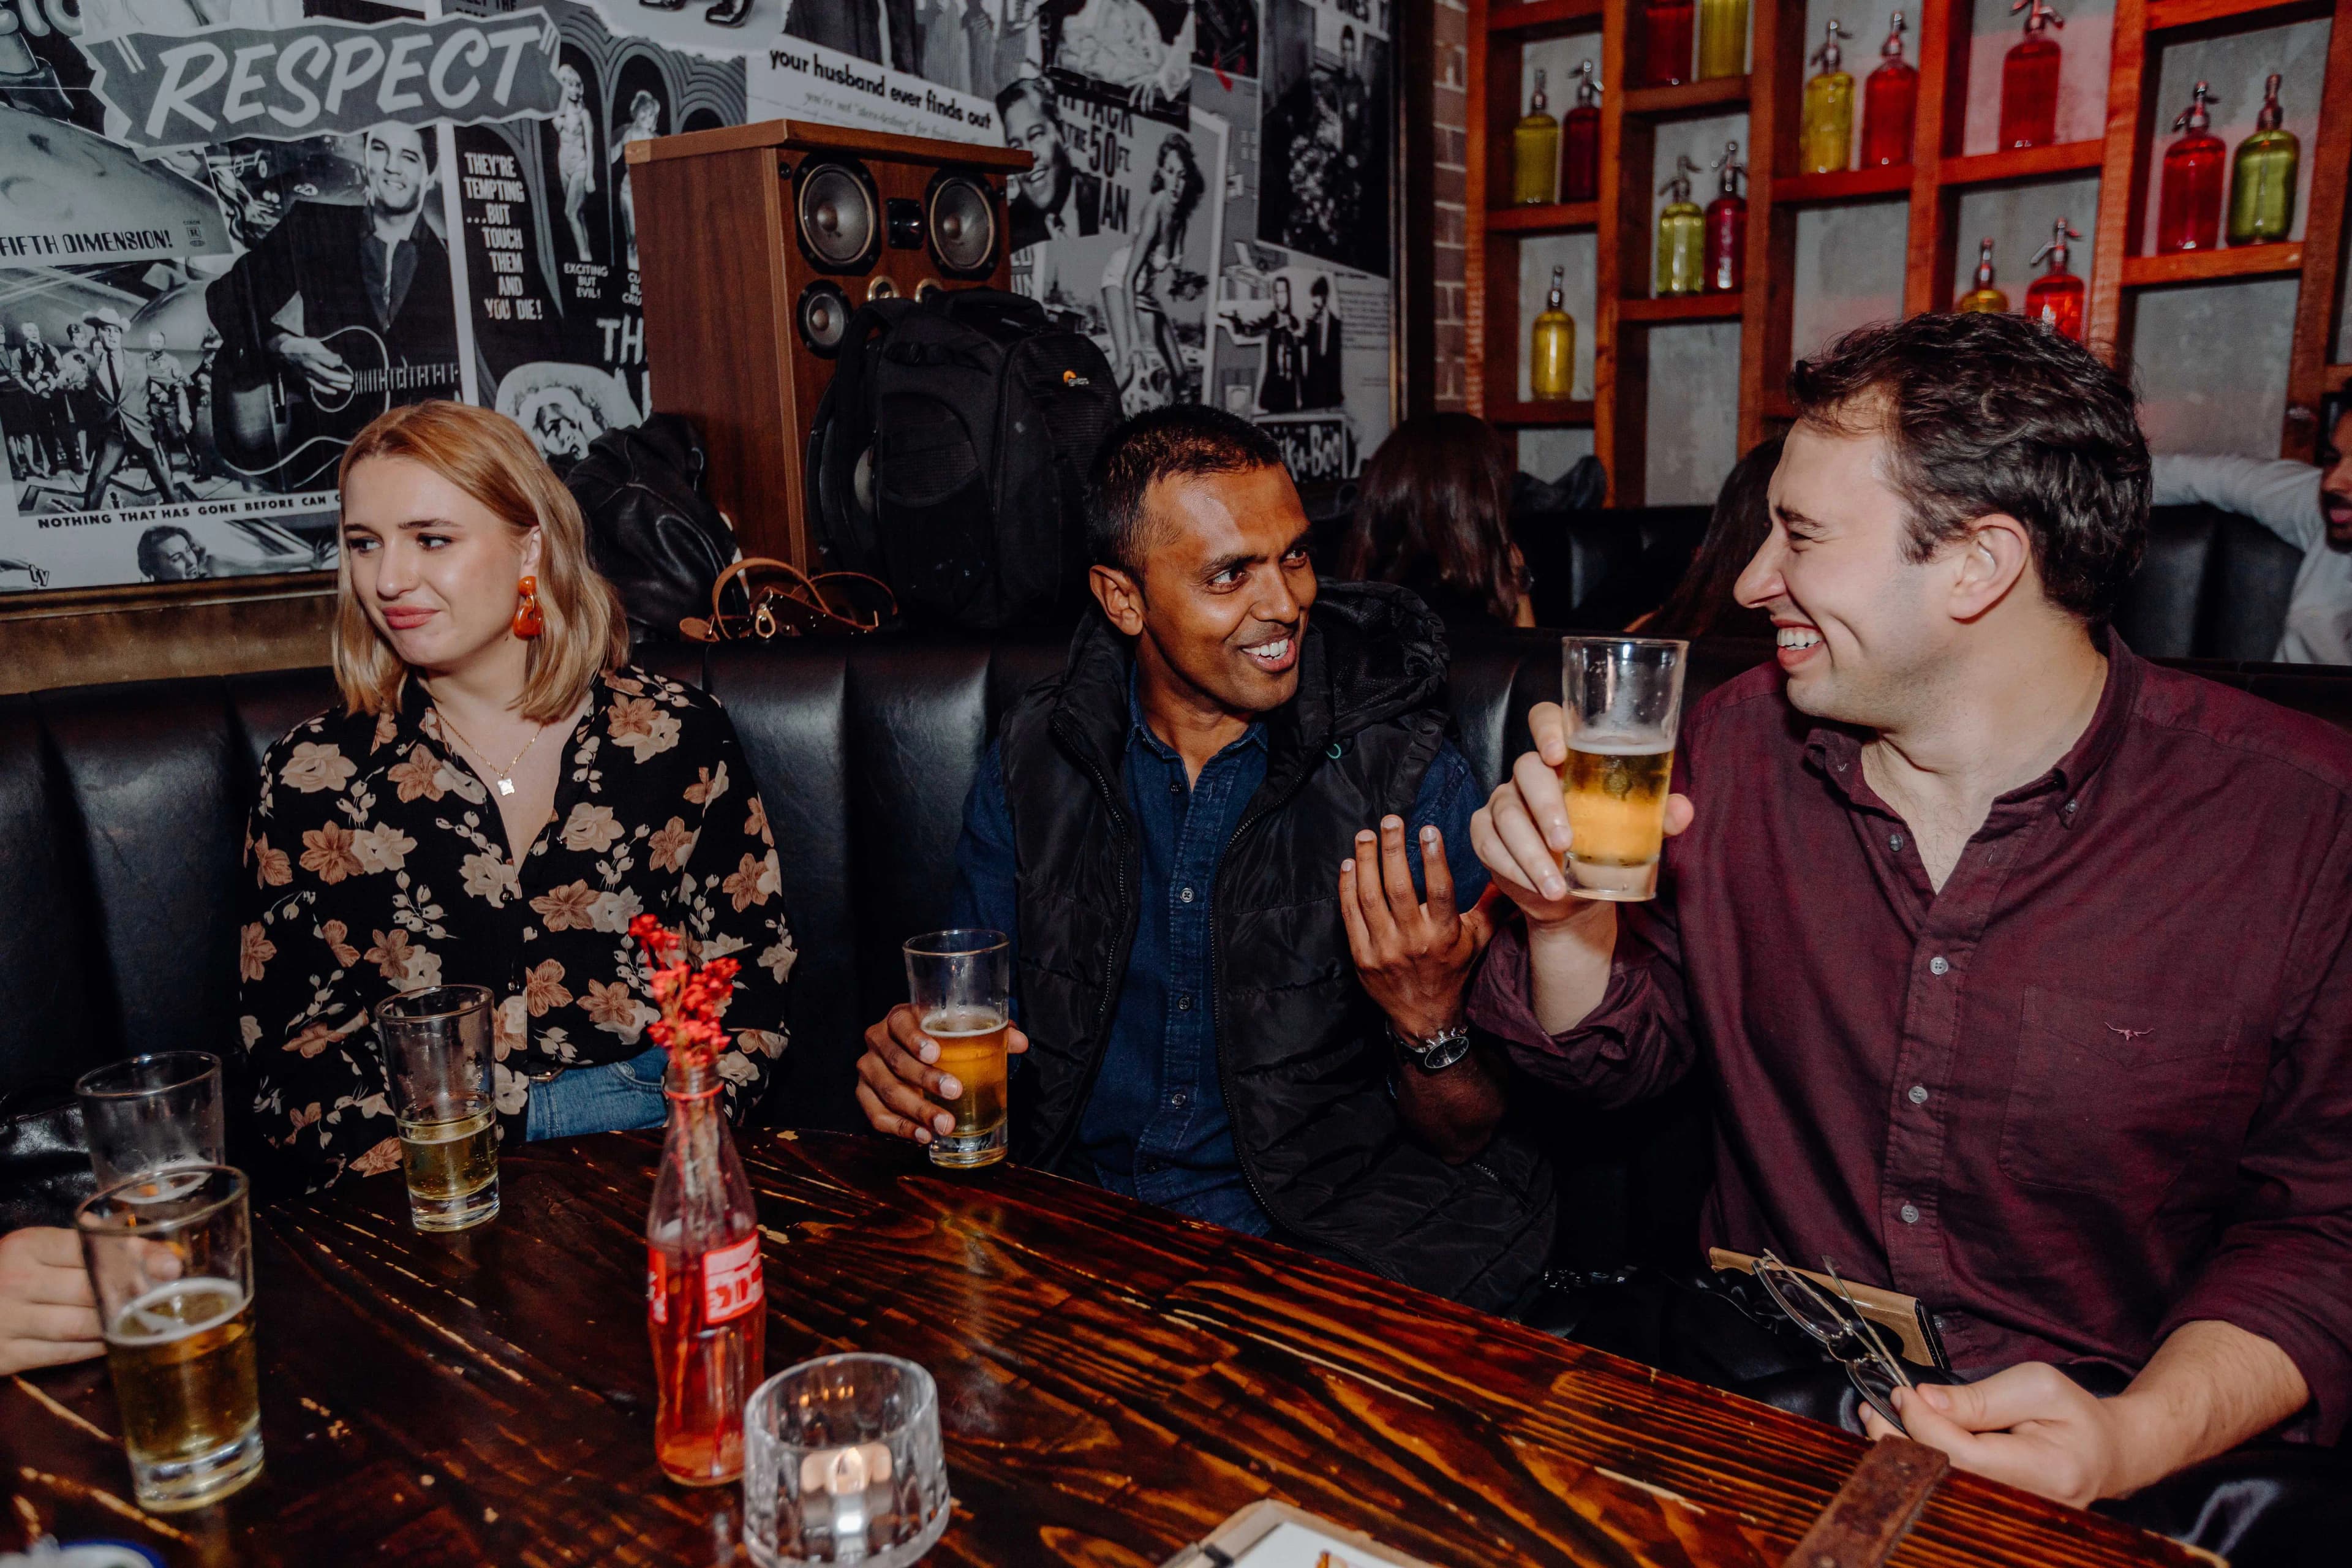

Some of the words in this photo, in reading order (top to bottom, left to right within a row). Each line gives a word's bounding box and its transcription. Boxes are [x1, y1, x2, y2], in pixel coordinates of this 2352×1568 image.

[770, 50, 810, 74] your
[813, 53, 885, 97] husband
[891, 86, 921, 108] ever
[926, 89, 963, 122] finds
[968, 111, 992, 129] out
[1089, 124, 1117, 178] 50
[464, 152, 517, 178] THEY'RE
[463, 177, 525, 203] TEMPTING
[0, 235, 59, 257] FIFTH
[62, 229, 173, 254] DIMENSION!
[481, 227, 524, 250] TOUCH
[489, 251, 524, 273] THEM
[564, 262, 609, 277] EXCITING
[499, 275, 524, 296] AND
[576, 287, 601, 299] EVIL!
[578, 276, 597, 288] BUT
[484, 298, 511, 320] YOU
[516, 298, 543, 320] DIE!
[596, 311, 648, 366] TH
[38, 513, 112, 529] NOTHING
[119, 510, 156, 522] THAT
[162, 507, 190, 519] HAS
[198, 503, 236, 515] GONE
[245, 499, 295, 511] BEFORE
[302, 496, 326, 507] CAN
